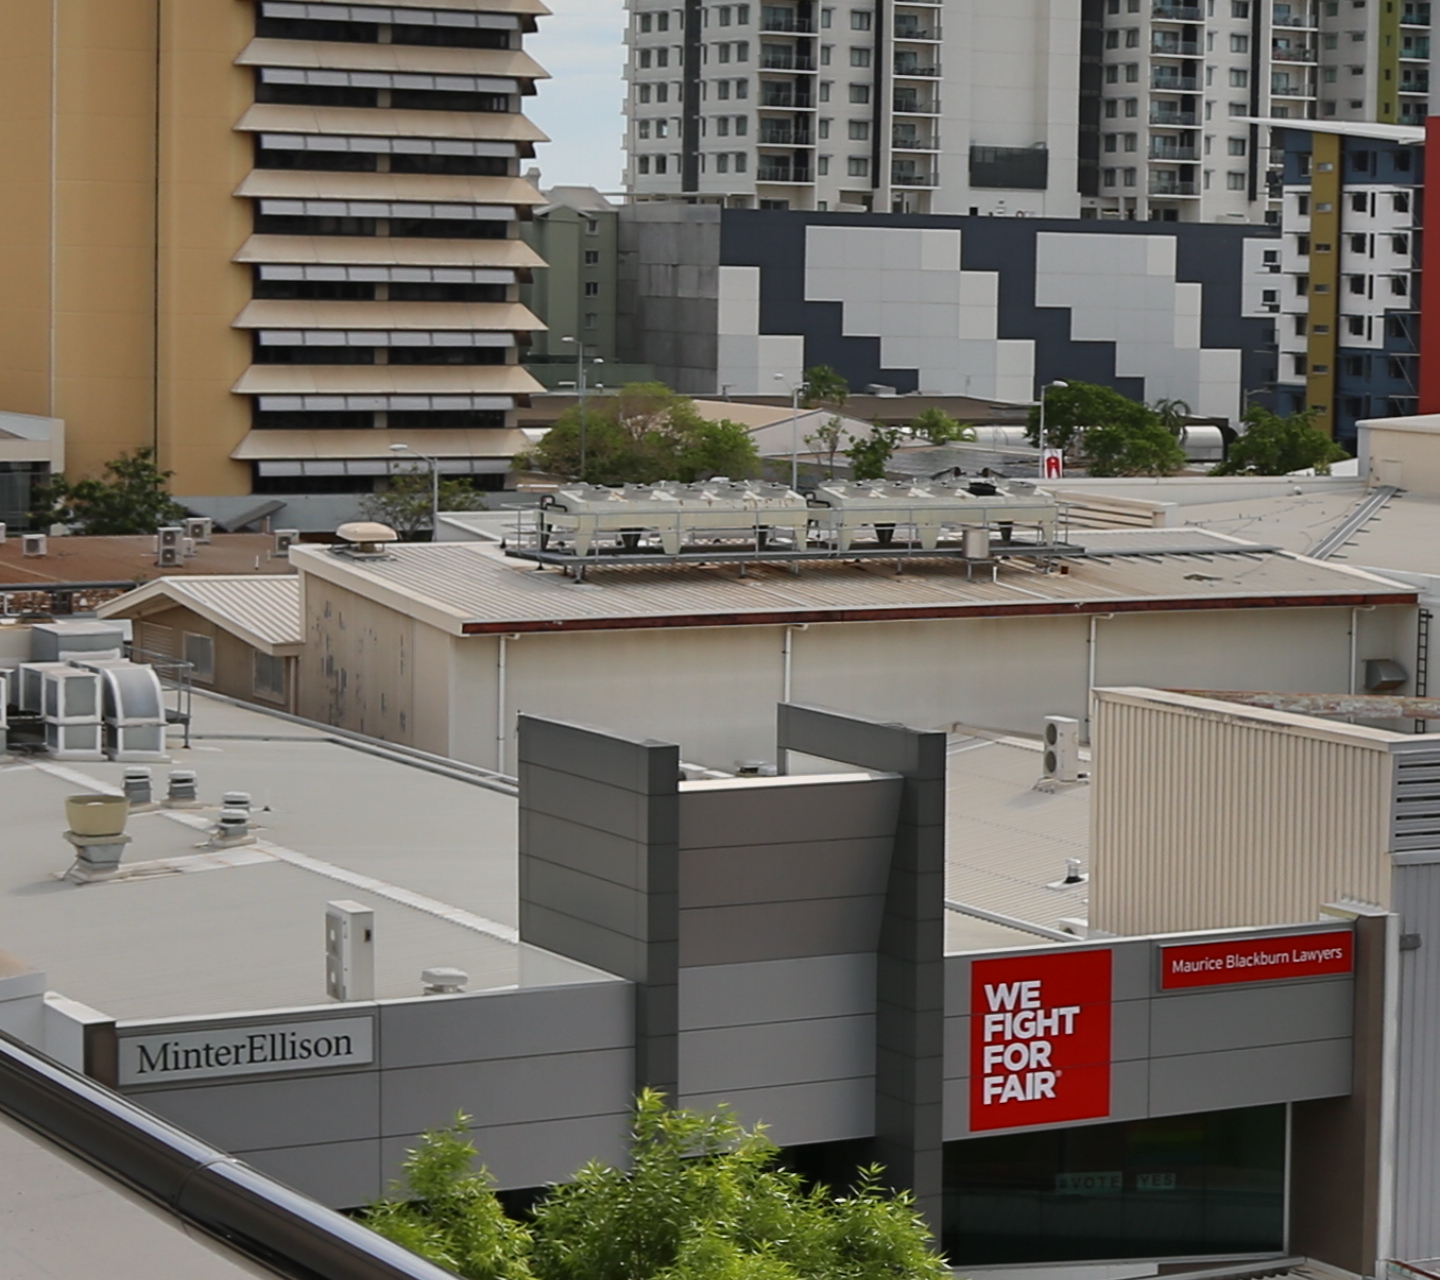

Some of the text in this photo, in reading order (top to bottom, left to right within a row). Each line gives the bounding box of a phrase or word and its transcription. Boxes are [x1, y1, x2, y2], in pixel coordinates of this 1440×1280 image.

[1172, 947, 1343, 974] Maurice Blackburn Lawyers
[983, 980, 1041, 1012] WE
[983, 1006, 1081, 1042] FIGHT
[137, 1032, 353, 1074] MinterEllison
[983, 1040, 1052, 1074] FOR
[983, 1070, 1058, 1105] FAIR
[1138, 1174, 1174, 1187] YES
